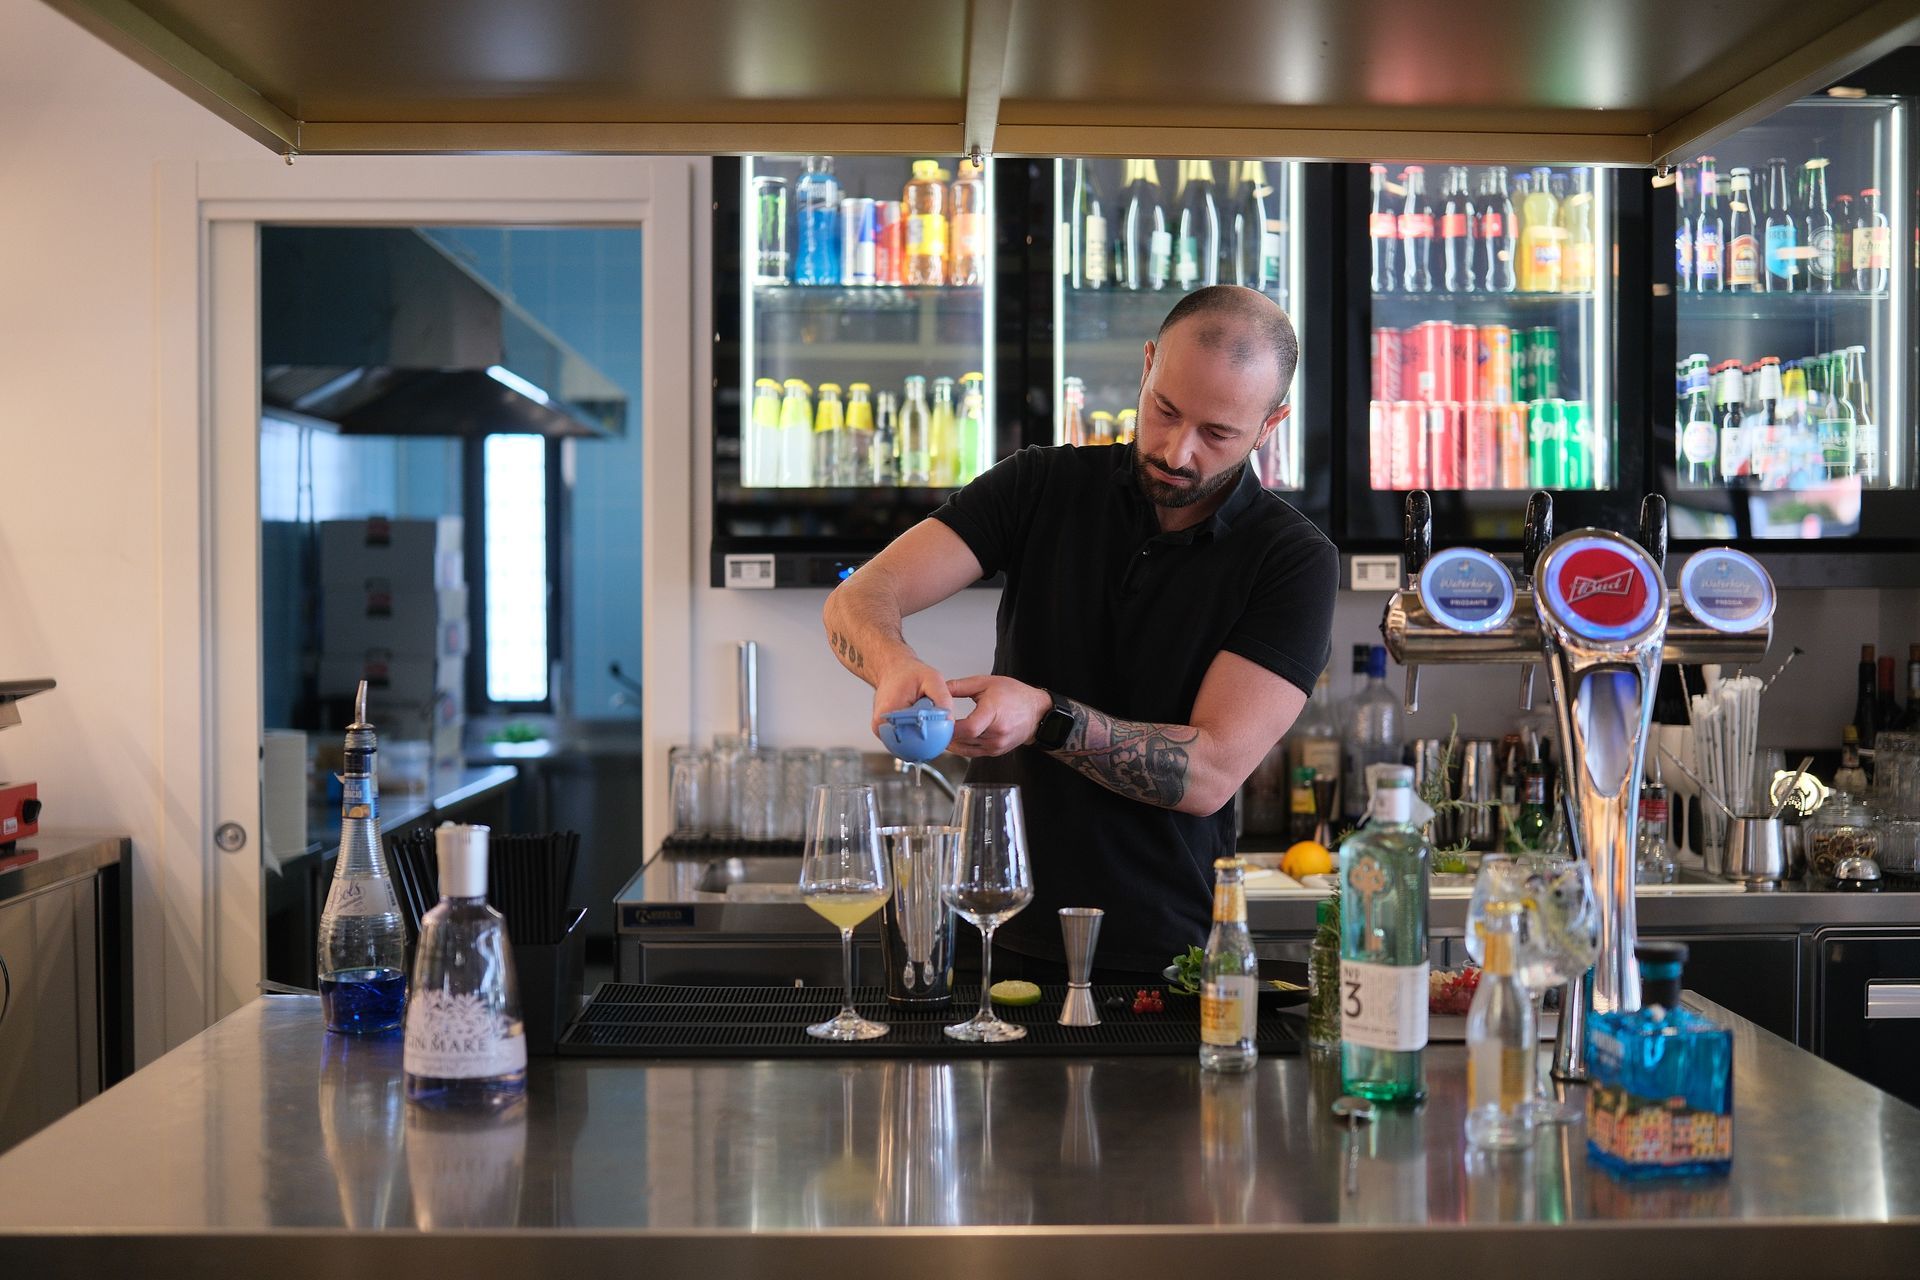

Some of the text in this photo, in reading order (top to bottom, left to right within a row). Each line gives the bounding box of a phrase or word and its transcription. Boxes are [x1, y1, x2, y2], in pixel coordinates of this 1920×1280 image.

[1577, 577, 1622, 595] Bud
[1345, 981, 1362, 1018] 3
[431, 1039, 489, 1053] MARE
